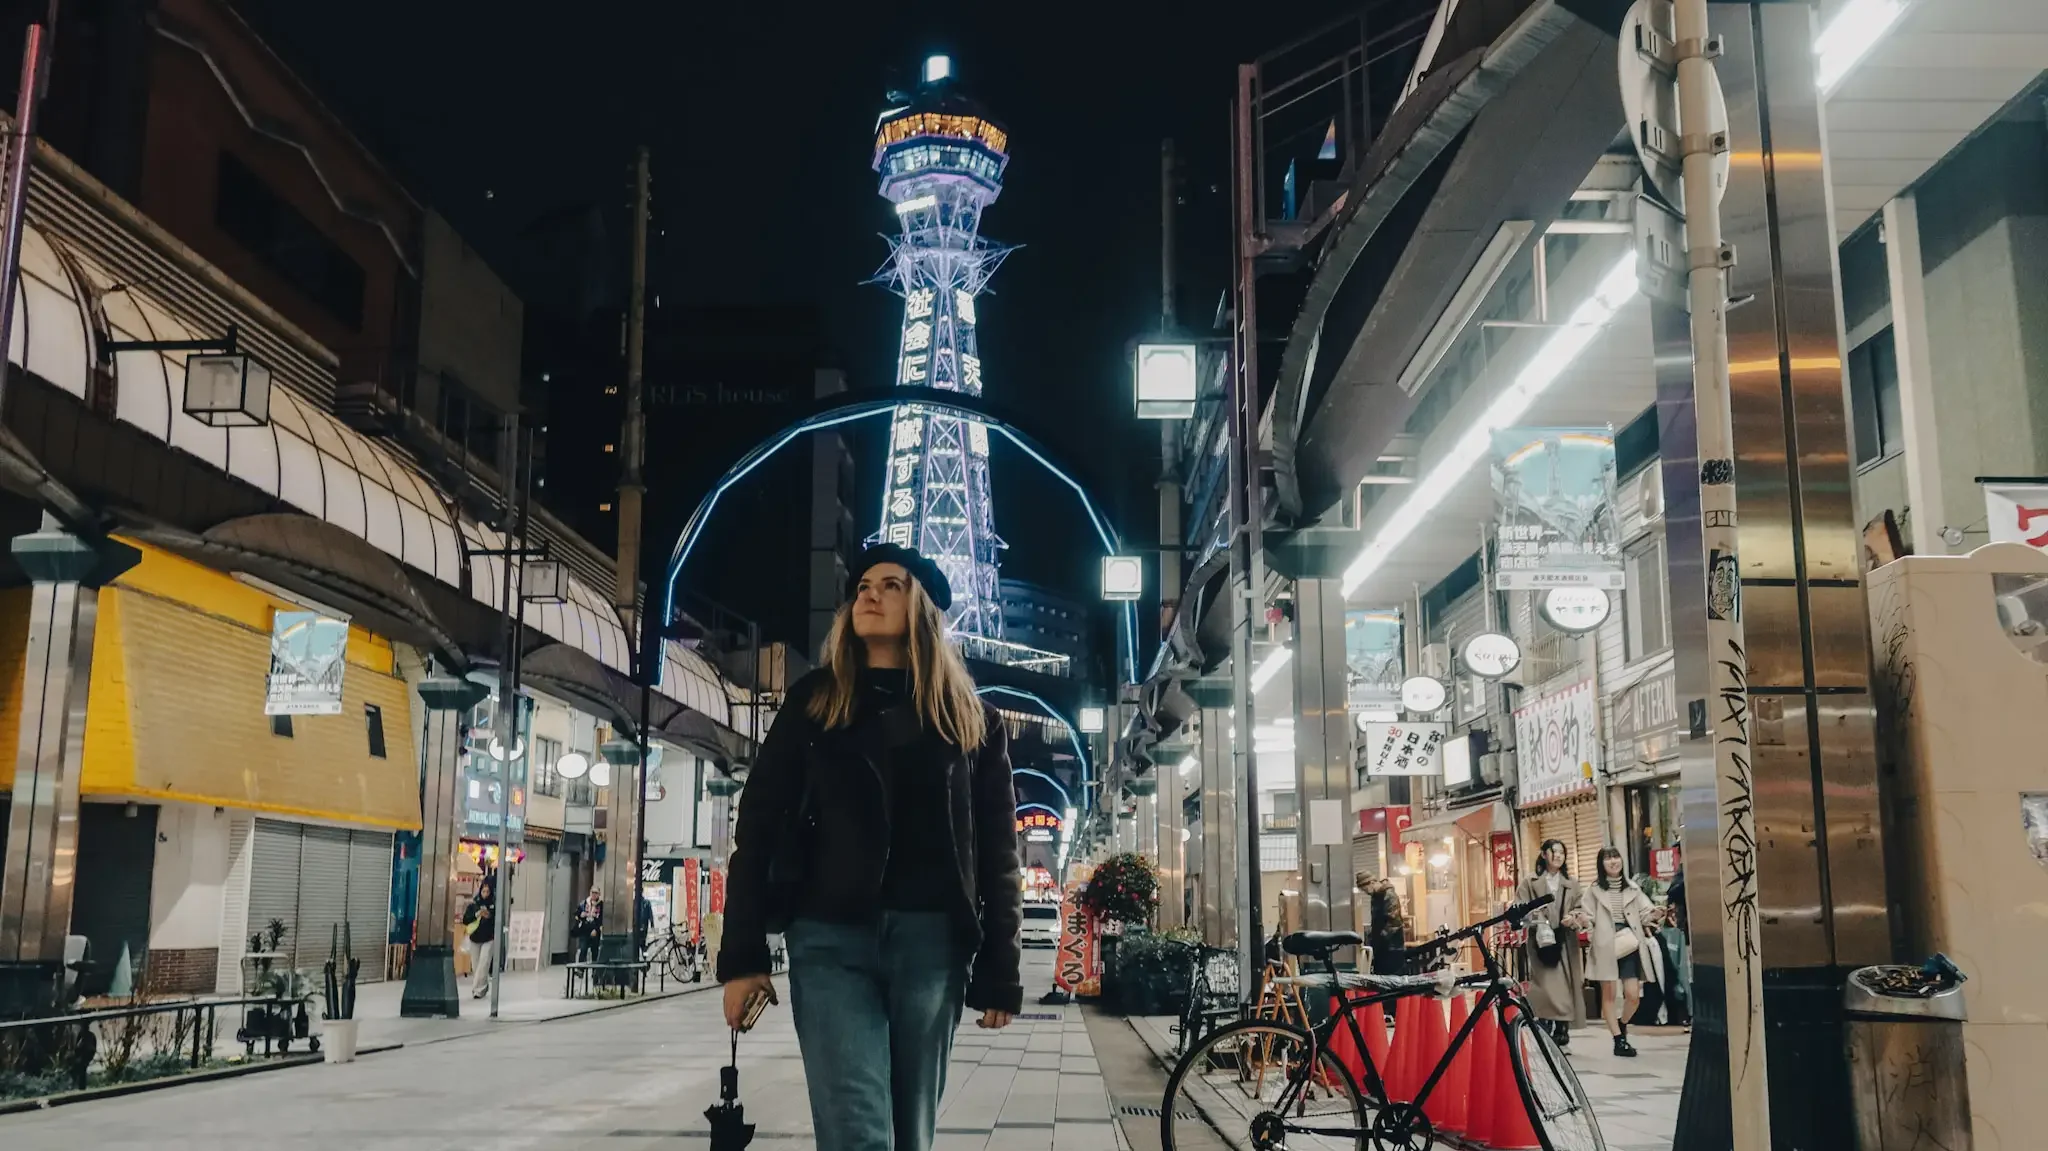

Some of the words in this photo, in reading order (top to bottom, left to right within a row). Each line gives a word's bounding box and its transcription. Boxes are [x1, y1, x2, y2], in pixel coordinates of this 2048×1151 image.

[717, 380, 790, 405] house
[1394, 731, 1420, 770] 日本酒
